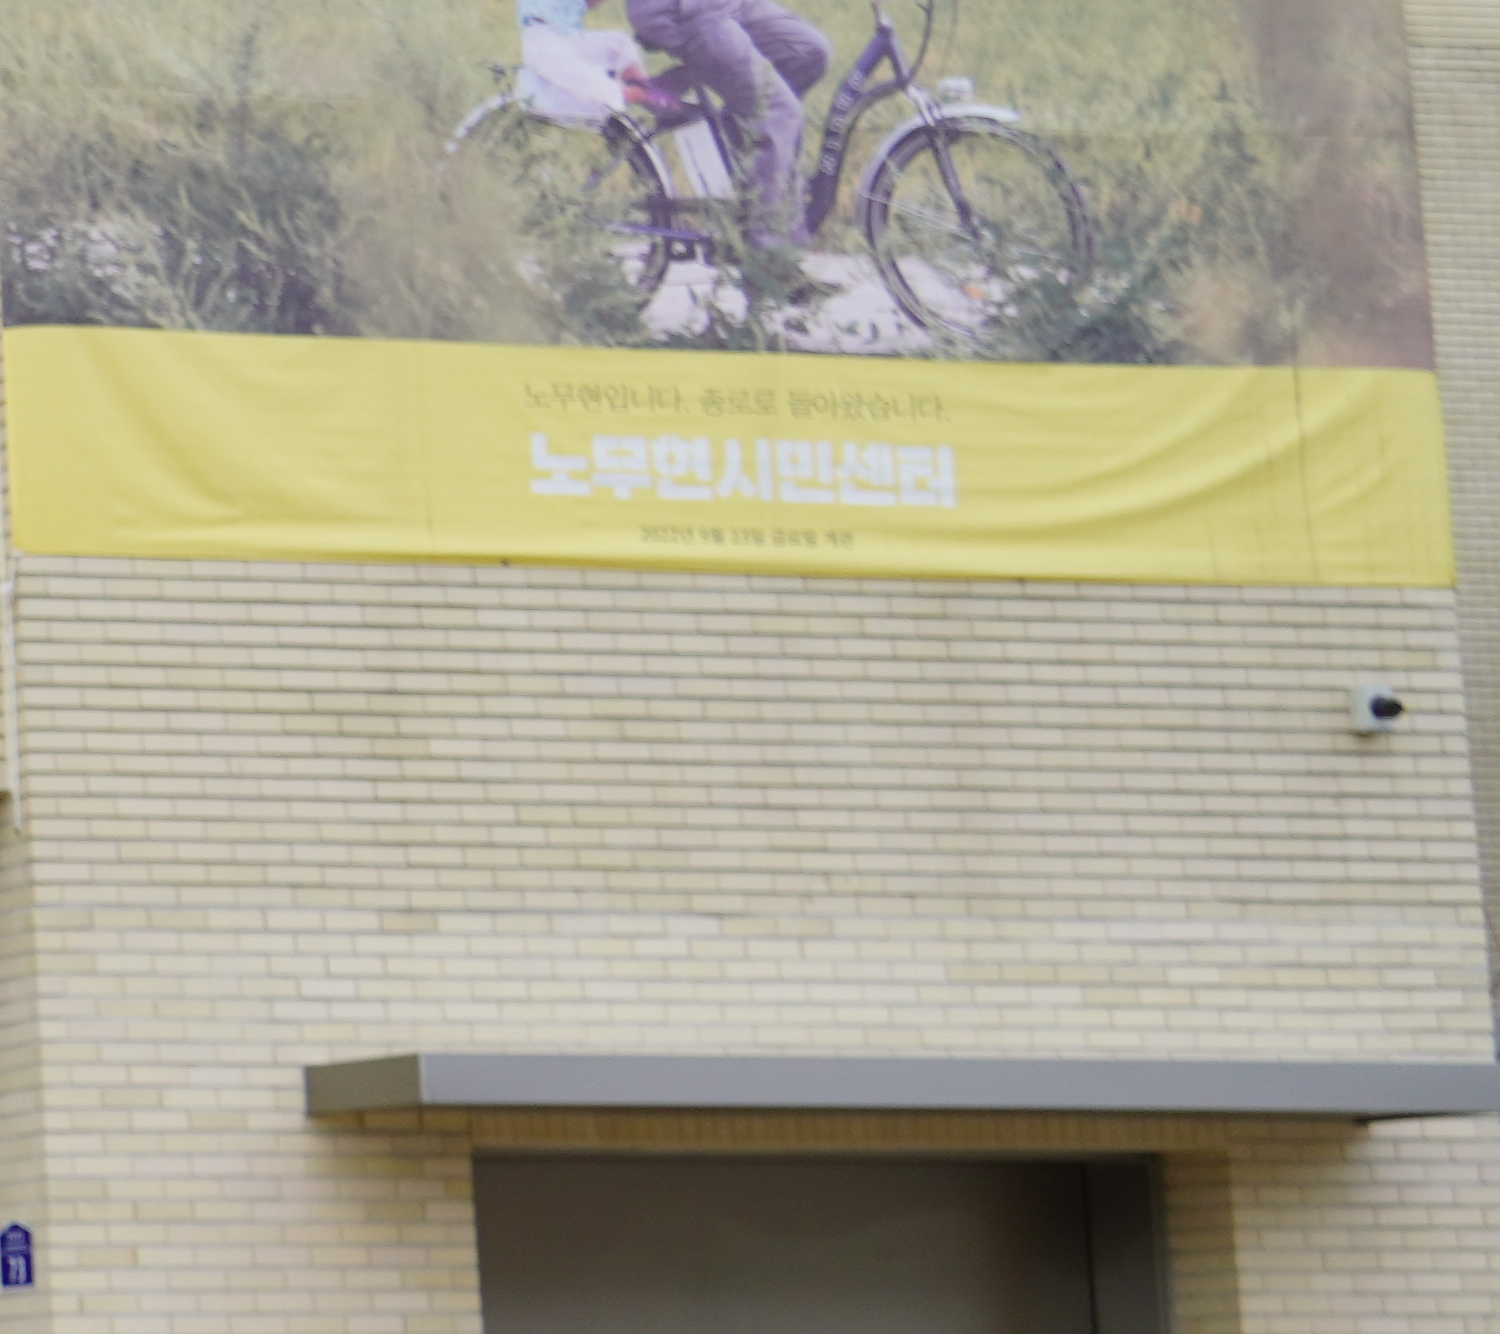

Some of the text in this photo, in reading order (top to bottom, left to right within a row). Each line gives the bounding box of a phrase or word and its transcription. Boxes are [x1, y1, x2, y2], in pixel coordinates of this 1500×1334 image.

[524, 383, 952, 423] 노무현입니다. 종로로 돌아왔습니다.
[529, 432, 957, 508] 노무현시민센터
